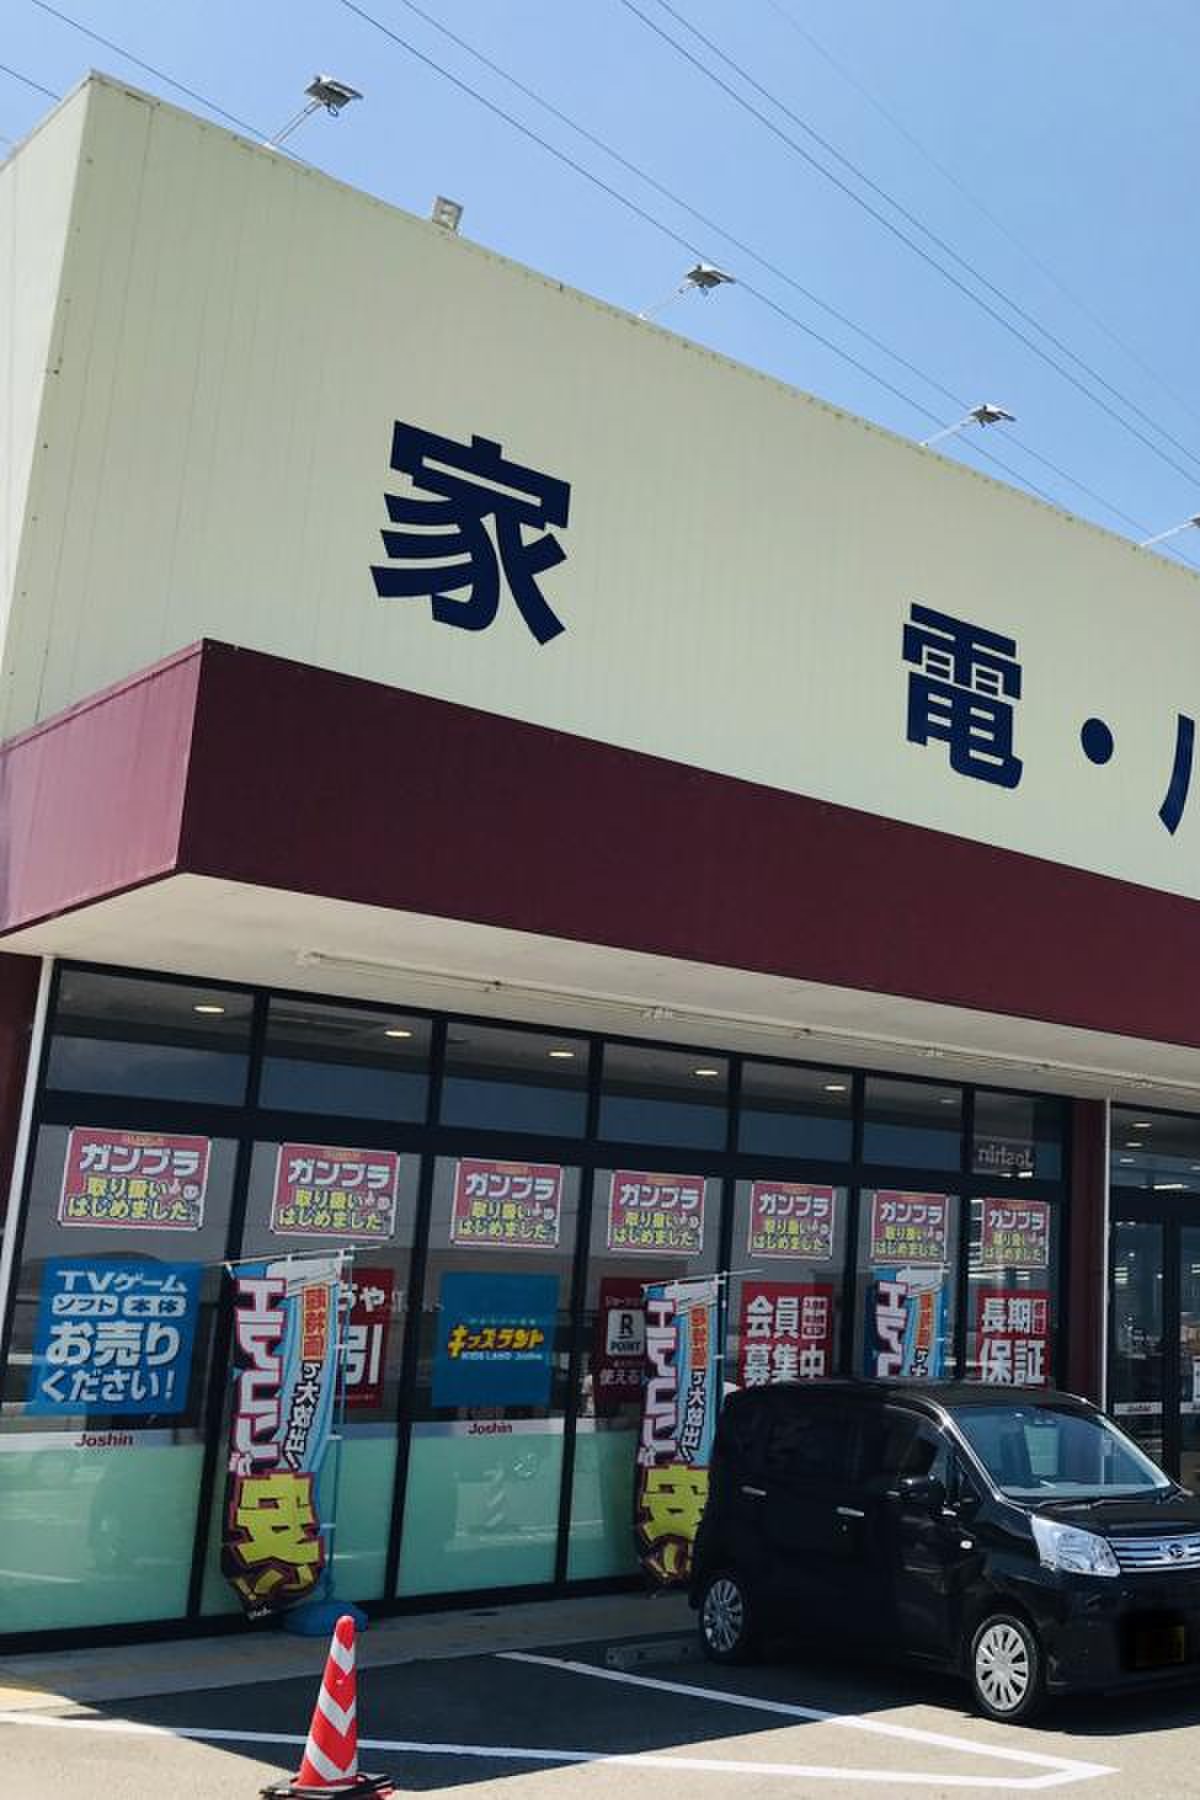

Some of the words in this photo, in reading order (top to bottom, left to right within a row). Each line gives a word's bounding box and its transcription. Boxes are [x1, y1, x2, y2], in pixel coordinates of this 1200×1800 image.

[79, 1143, 200, 1177] ガンプラ
[287, 1158, 391, 1189] ガンプラ
[464, 1172, 556, 1202] ガンプラ
[619, 1183, 700, 1210] ガンプラ
[758, 1193, 829, 1218] ガンプラ
[57, 1270, 188, 1293] TVゲーム
[55, 1296, 115, 1314] ソフト
[131, 1297, 180, 1315] 本体
[746, 1295, 800, 1339] 会員
[981, 1297, 1031, 1334] 長期
[46, 1321, 181, 1367] お売り
[743, 1343, 826, 1389] 募集中
[979, 1338, 1046, 1388] 保証
[75, 1433, 134, 1448] Joshin
[468, 1422, 513, 1435] Joshin
